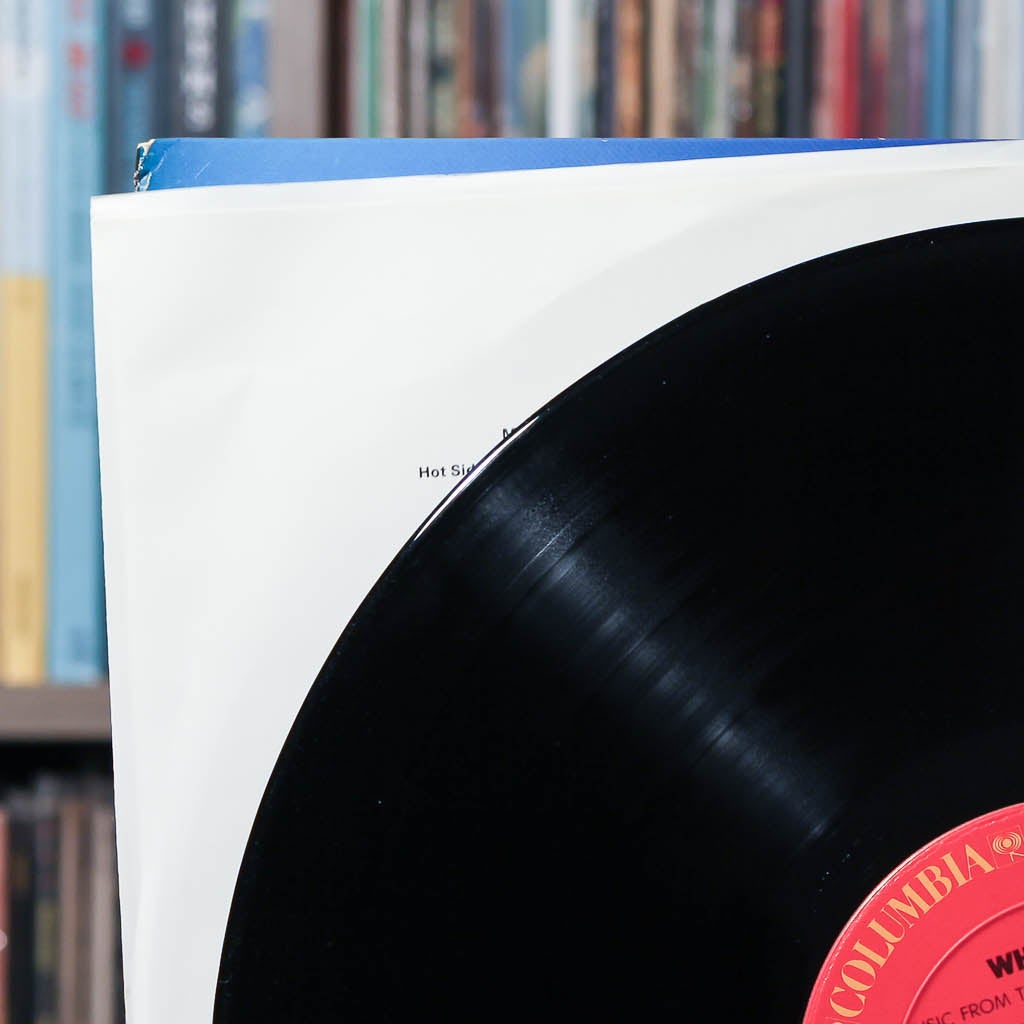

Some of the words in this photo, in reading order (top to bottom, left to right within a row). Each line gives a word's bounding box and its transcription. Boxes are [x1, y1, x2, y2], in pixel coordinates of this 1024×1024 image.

[419, 466, 446, 478] Hot
[451, 463, 477, 477] Sid
[829, 844, 995, 1018] COLUMBIA
[960, 992, 1012, 1021] FROM
